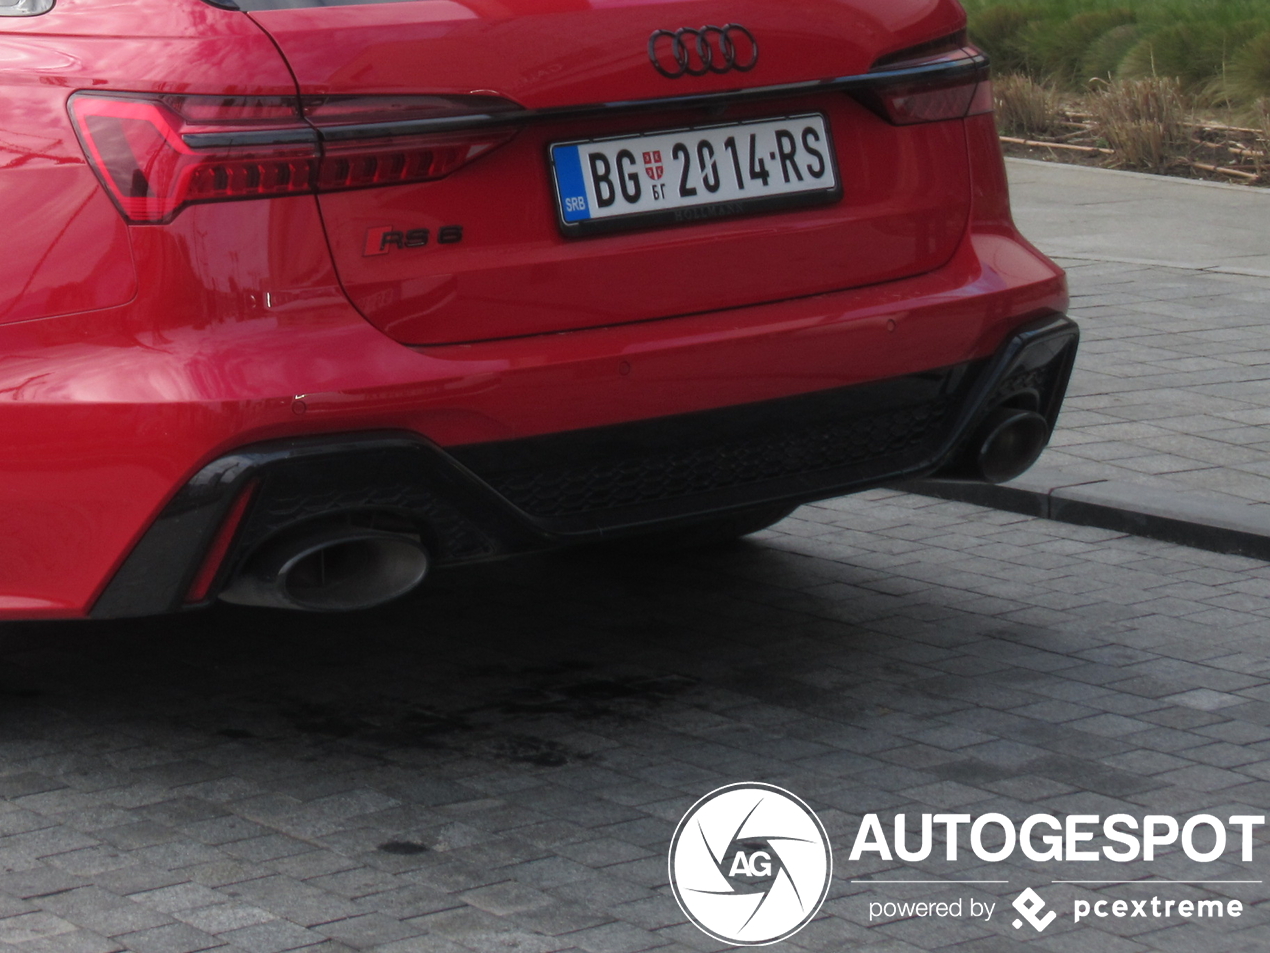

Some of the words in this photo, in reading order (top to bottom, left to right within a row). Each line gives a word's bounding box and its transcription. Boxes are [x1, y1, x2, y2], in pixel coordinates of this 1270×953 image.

[588, 149, 642, 209] BG
[565, 196, 586, 212] SRB
[380, 229, 430, 250] RS
[438, 225, 462, 243] 6
